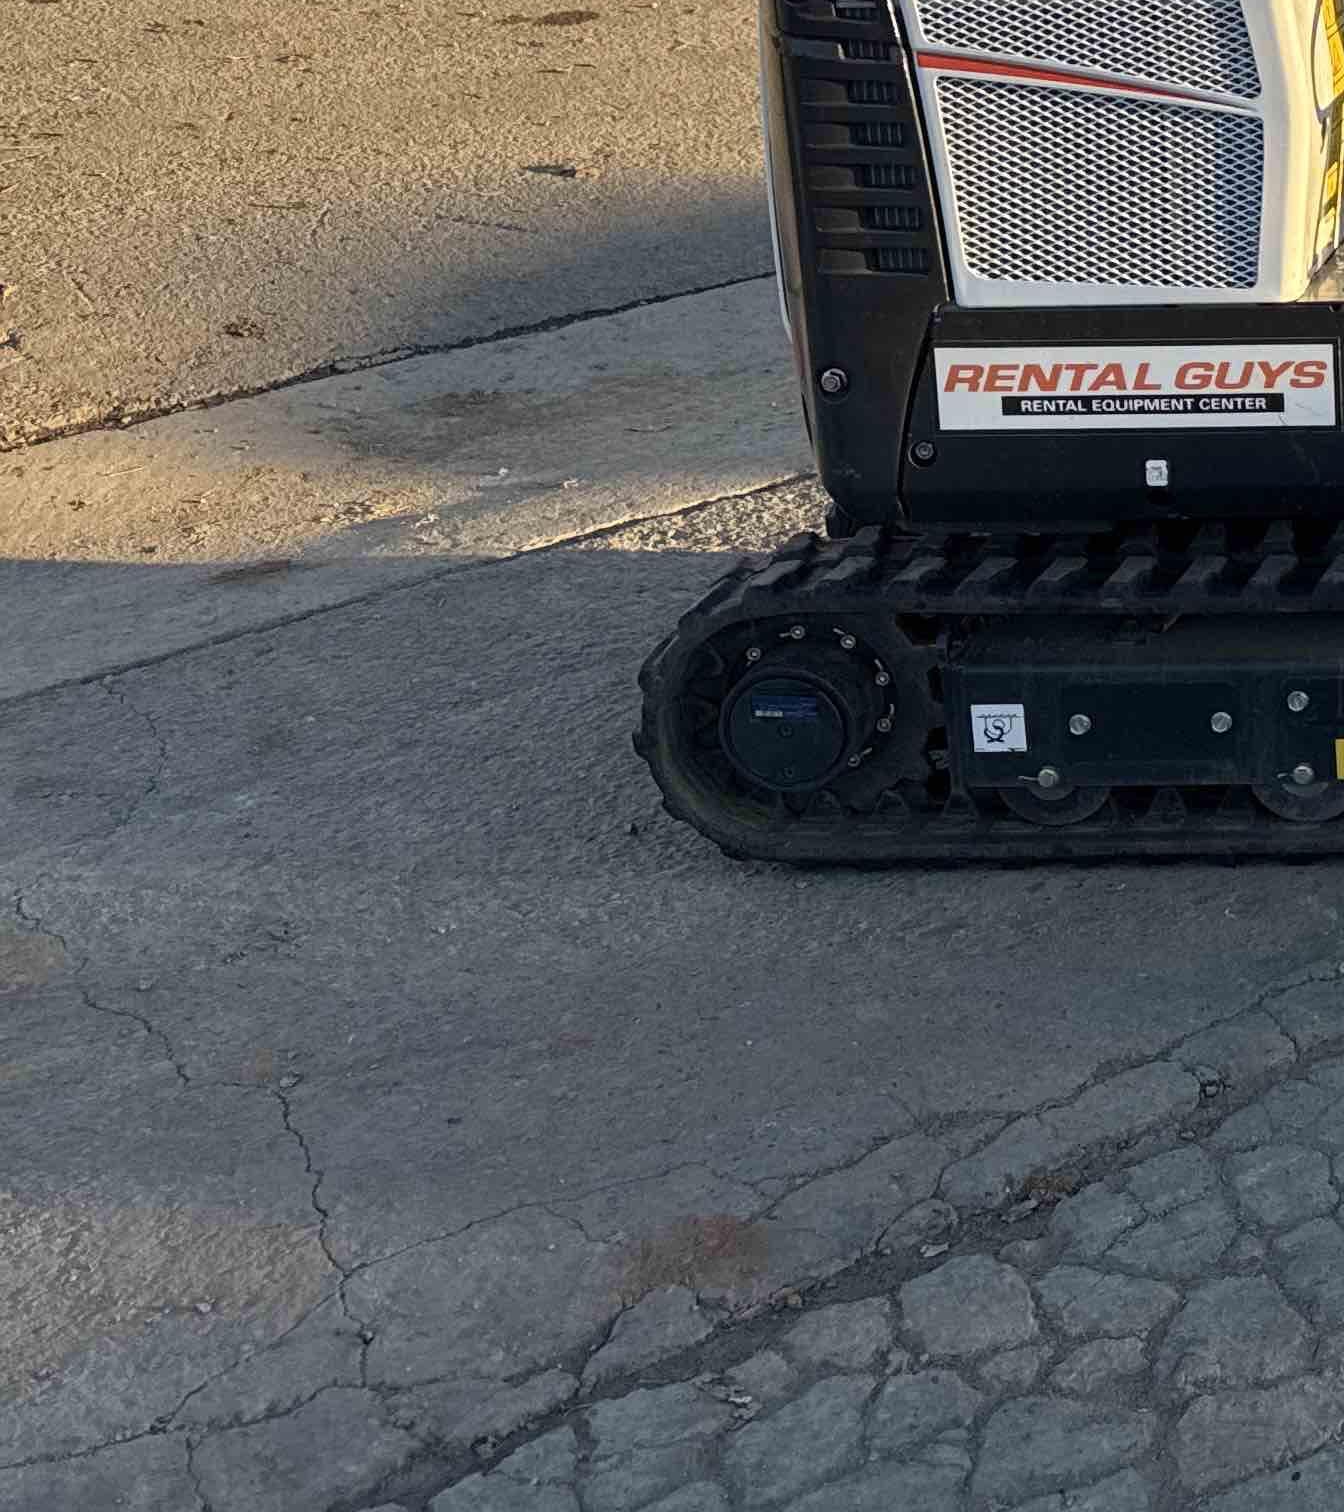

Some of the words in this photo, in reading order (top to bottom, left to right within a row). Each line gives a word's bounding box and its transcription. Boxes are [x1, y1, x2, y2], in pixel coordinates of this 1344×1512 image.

[943, 362, 1162, 393] RENTAL
[1174, 360, 1328, 392] GUYS
[1020, 399, 1088, 413] RENTAL
[1092, 398, 1195, 413] EQUIPMENT
[1199, 397, 1267, 412] CENTER
